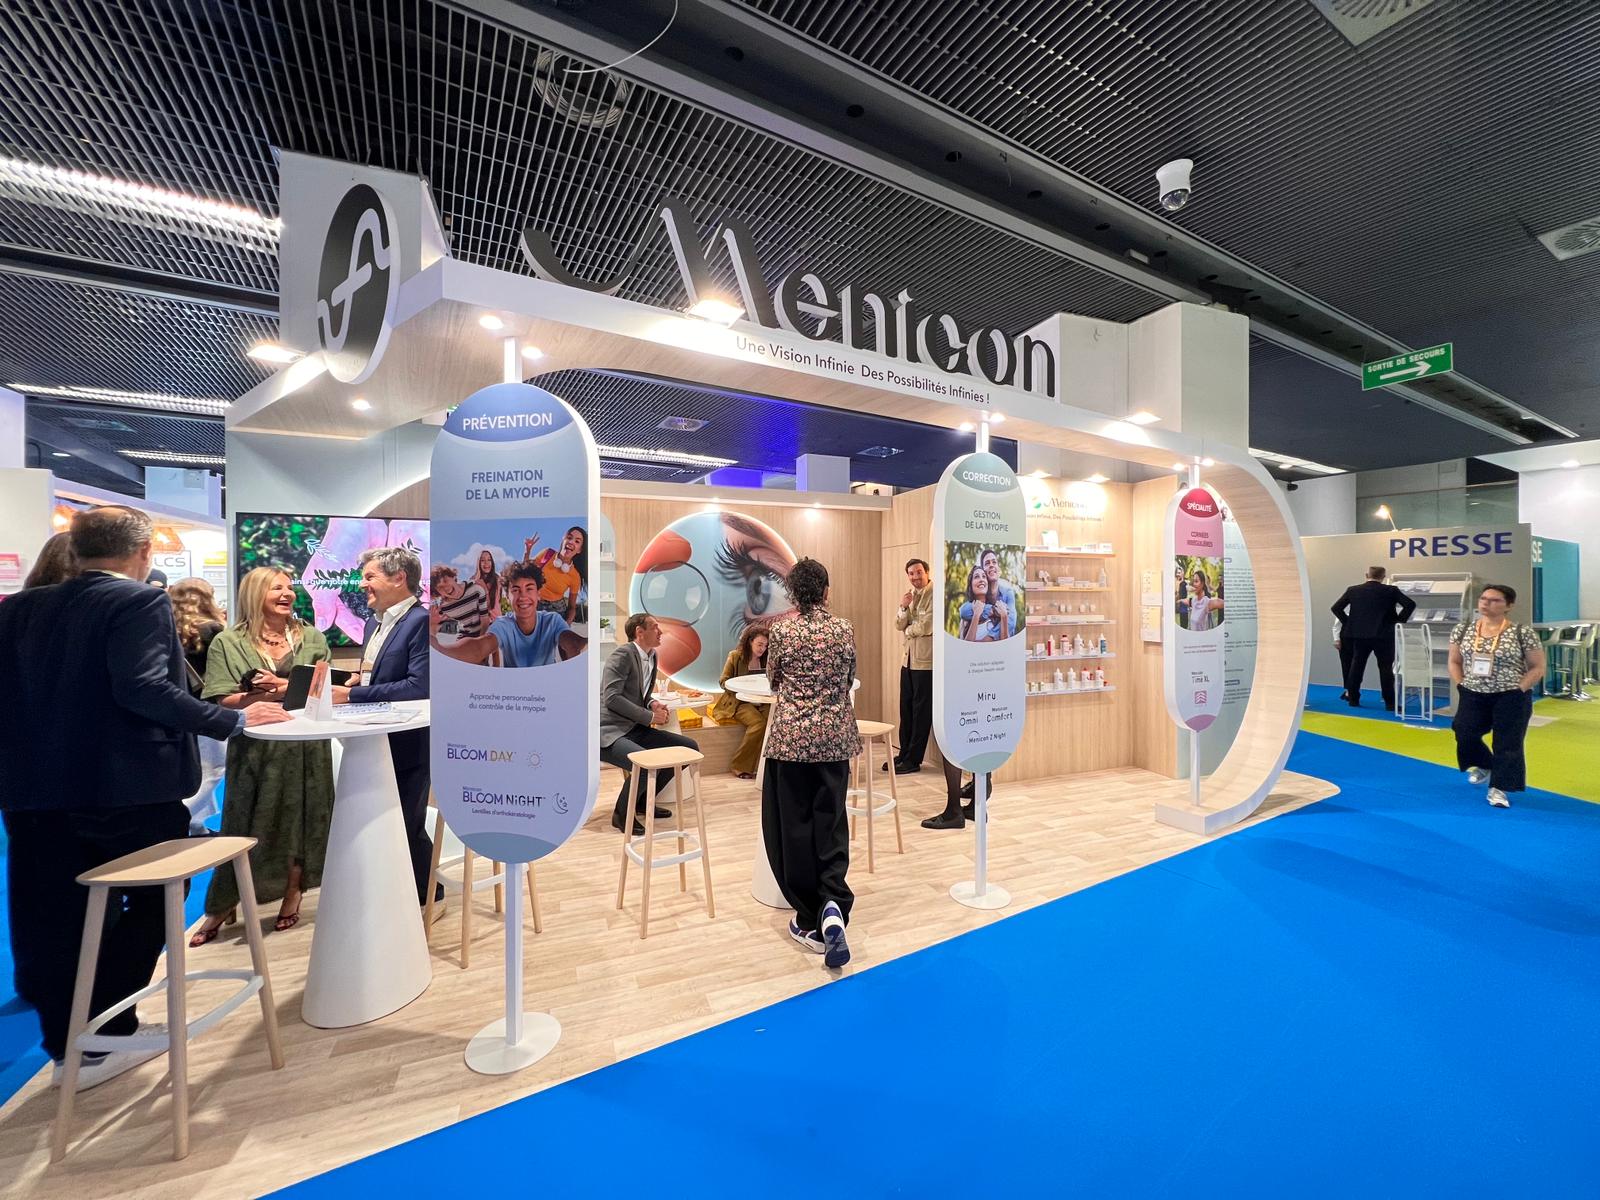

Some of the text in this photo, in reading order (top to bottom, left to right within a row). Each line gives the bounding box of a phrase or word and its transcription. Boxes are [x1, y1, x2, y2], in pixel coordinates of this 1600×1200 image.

[519, 197, 1057, 398] Menicon
[1367, 347, 1446, 373] SORTIE DE SECOURS
[736, 335, 766, 354] Une
[769, 343, 811, 366] Vision
[815, 356, 855, 375] Infinie
[861, 364, 884, 382] Des
[887, 370, 947, 395] Possibilités
[949, 384, 985, 403] Infinies
[463, 412, 553, 431] PRÉVENTION
[471, 469, 544, 483] FREINATION
[962, 470, 1011, 486] CORRECTION
[465, 486, 550, 501] DE LA MYOPIE
[1186, 502, 1213, 512] SPÉCIALITÉ
[973, 510, 1001, 520] GESTION
[965, 520, 1009, 532] DE LA MYOPIE
[1389, 532, 1513, 559] PRESSE
[153, 555, 186, 567] LCS
[469, 693, 546, 703] Approche personnalisée
[977, 692, 996, 702] Miru
[505, 703, 513, 711] de
[515, 703, 521, 711] la
[522, 705, 547, 713] myopie
[959, 717, 978, 726] Omni
[986, 712, 1013, 722] Comfort
[447, 748, 514, 762] BLOOM DAY
[462, 791, 504, 805] BLOOM
